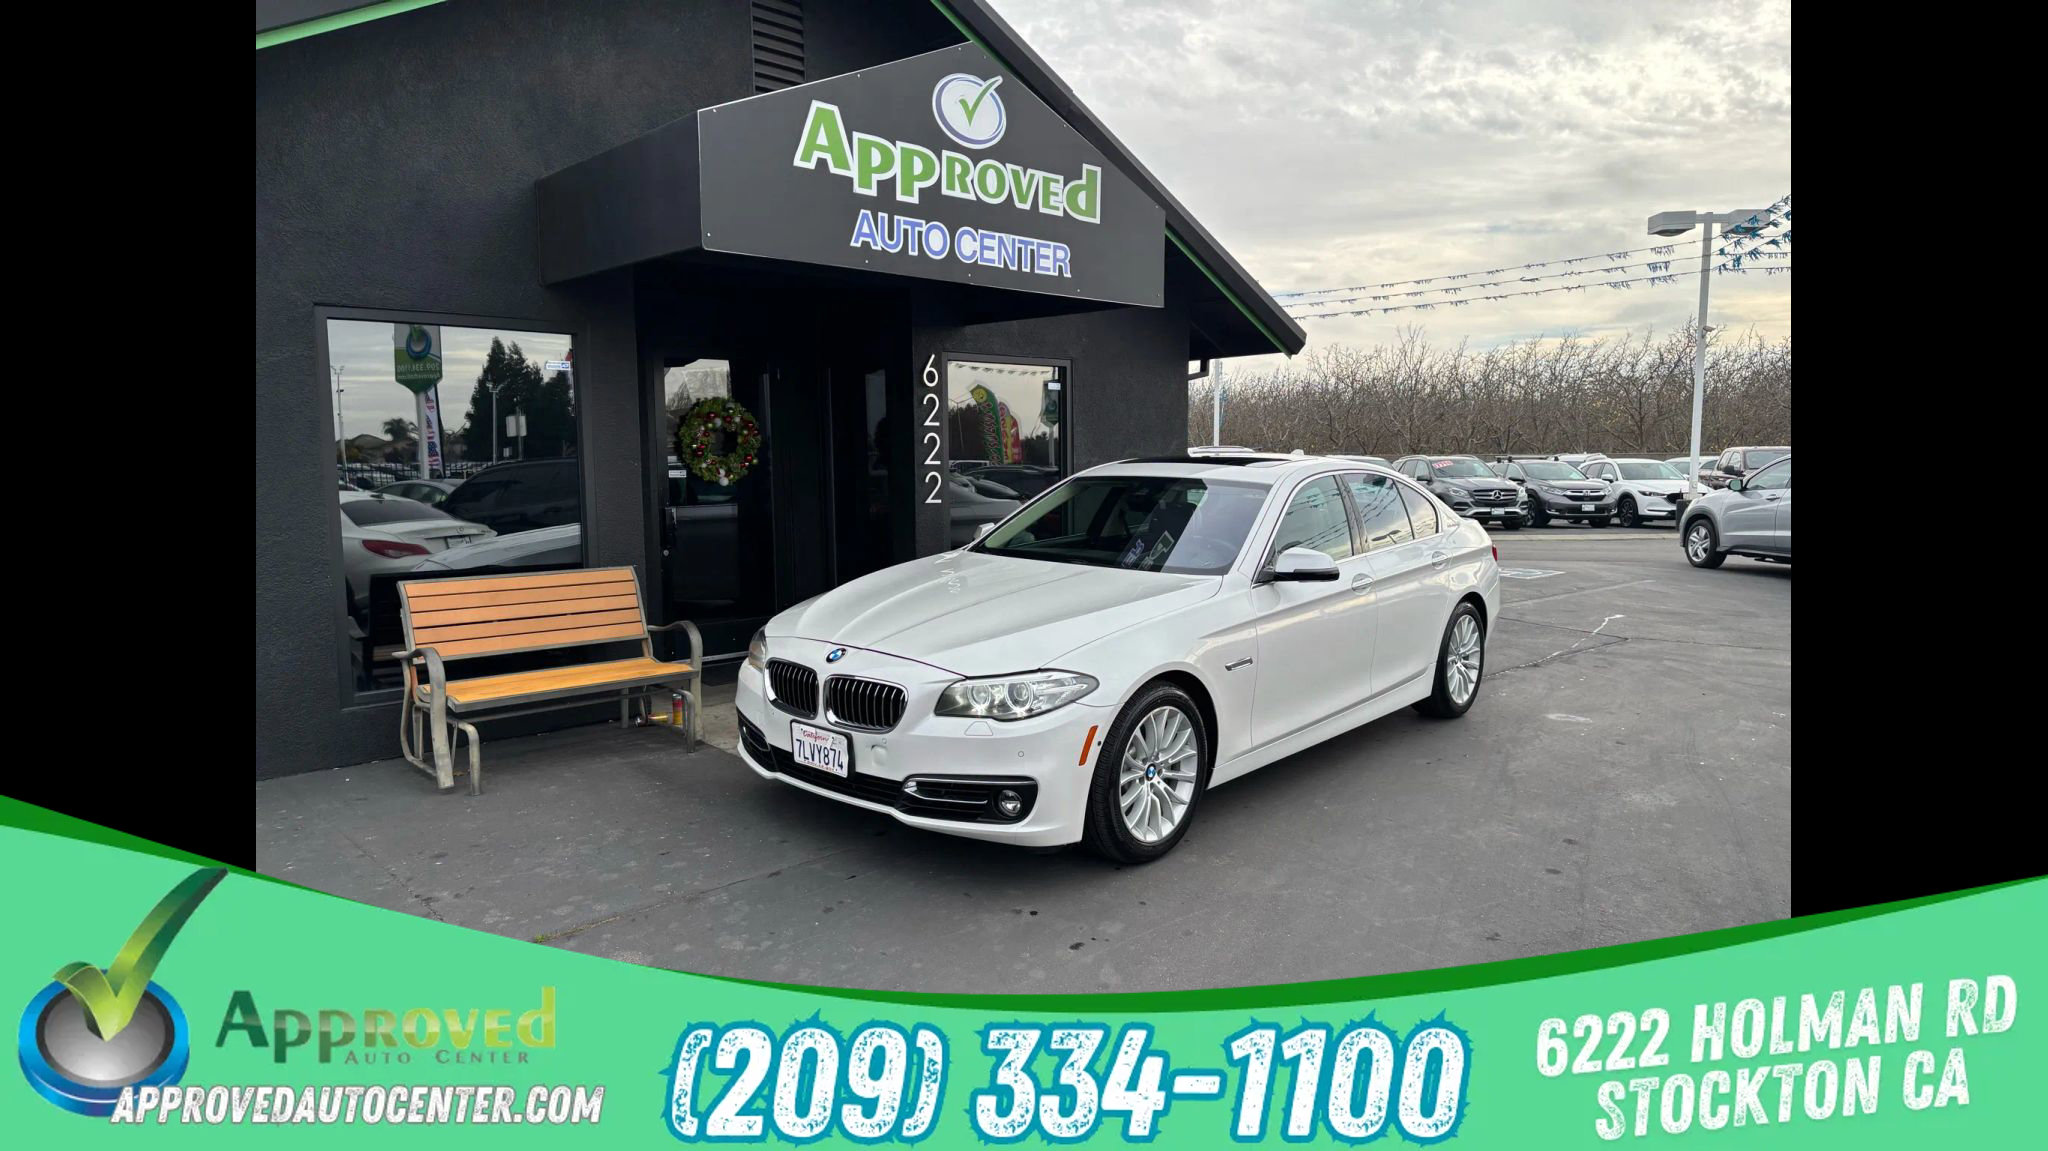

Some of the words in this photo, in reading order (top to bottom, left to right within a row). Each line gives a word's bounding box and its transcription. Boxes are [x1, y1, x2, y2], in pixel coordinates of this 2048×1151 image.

[850, 209, 950, 259] AUTO
[955, 226, 1072, 278] CENTER
[923, 354, 942, 503] 6222
[796, 738, 843, 770] 7LVY874
